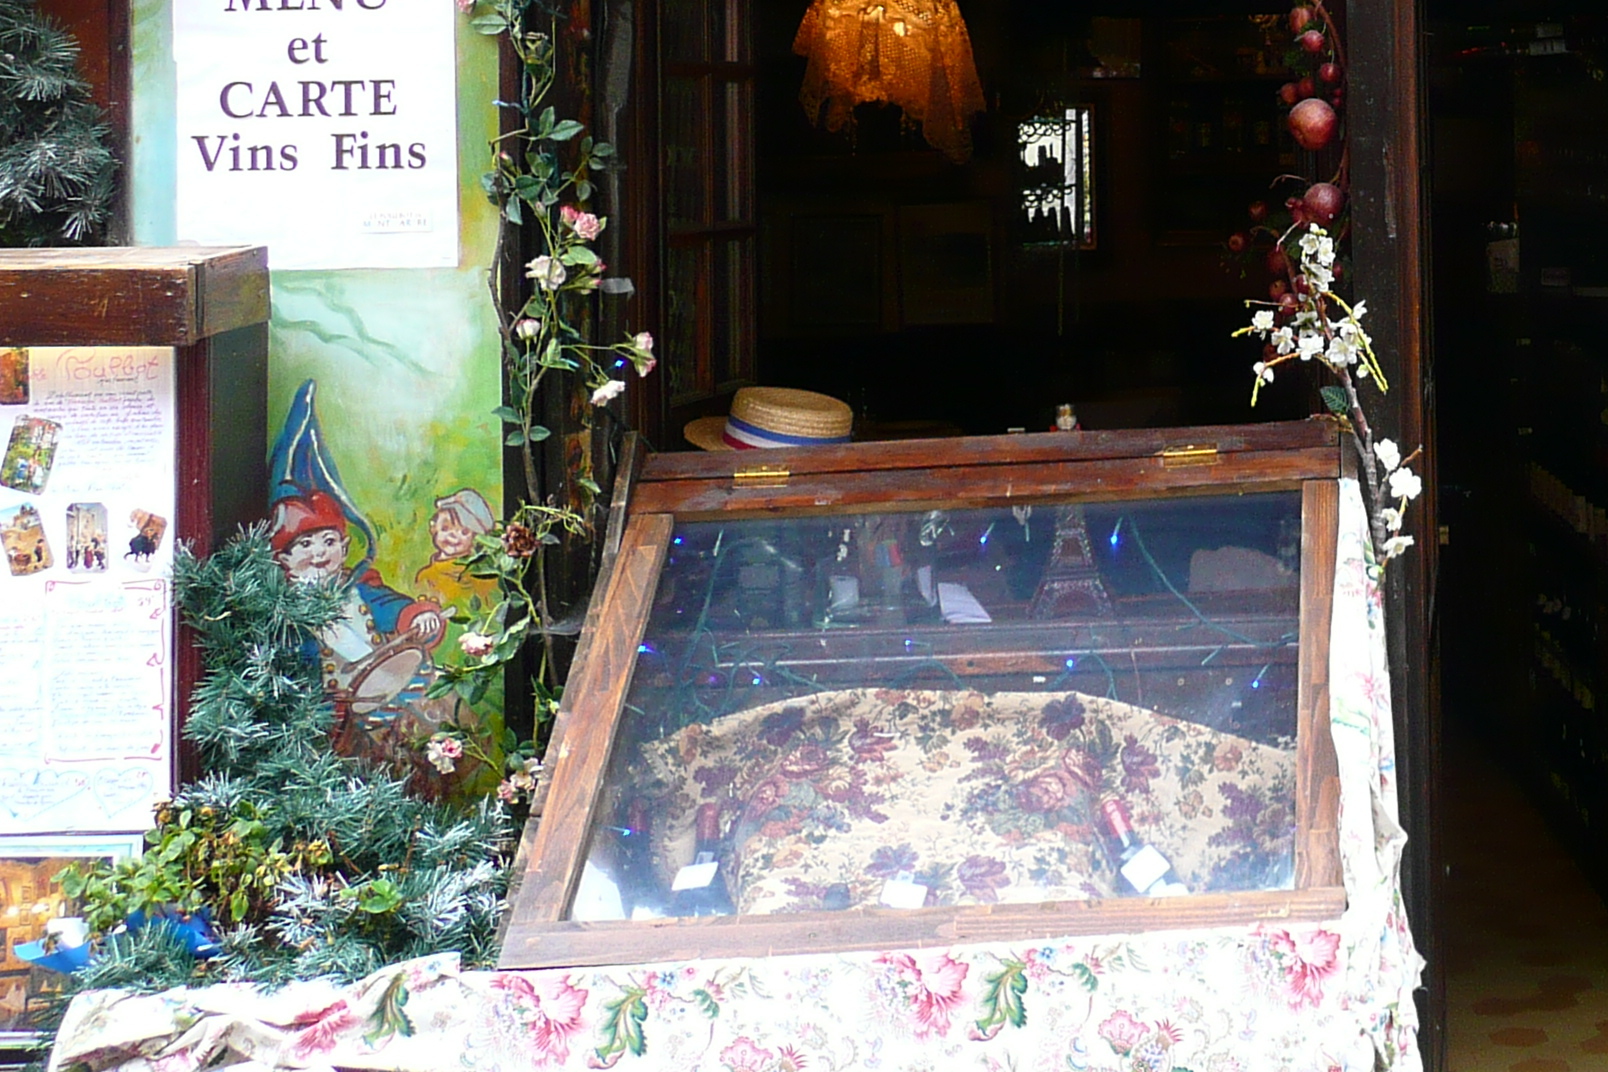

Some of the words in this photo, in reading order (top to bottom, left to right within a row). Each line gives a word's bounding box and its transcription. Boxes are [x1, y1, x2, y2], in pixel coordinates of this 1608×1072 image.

[287, 32, 329, 64] et
[219, 79, 397, 119] CARTE
[191, 132, 298, 172] Vins
[330, 130, 427, 170] Fins
